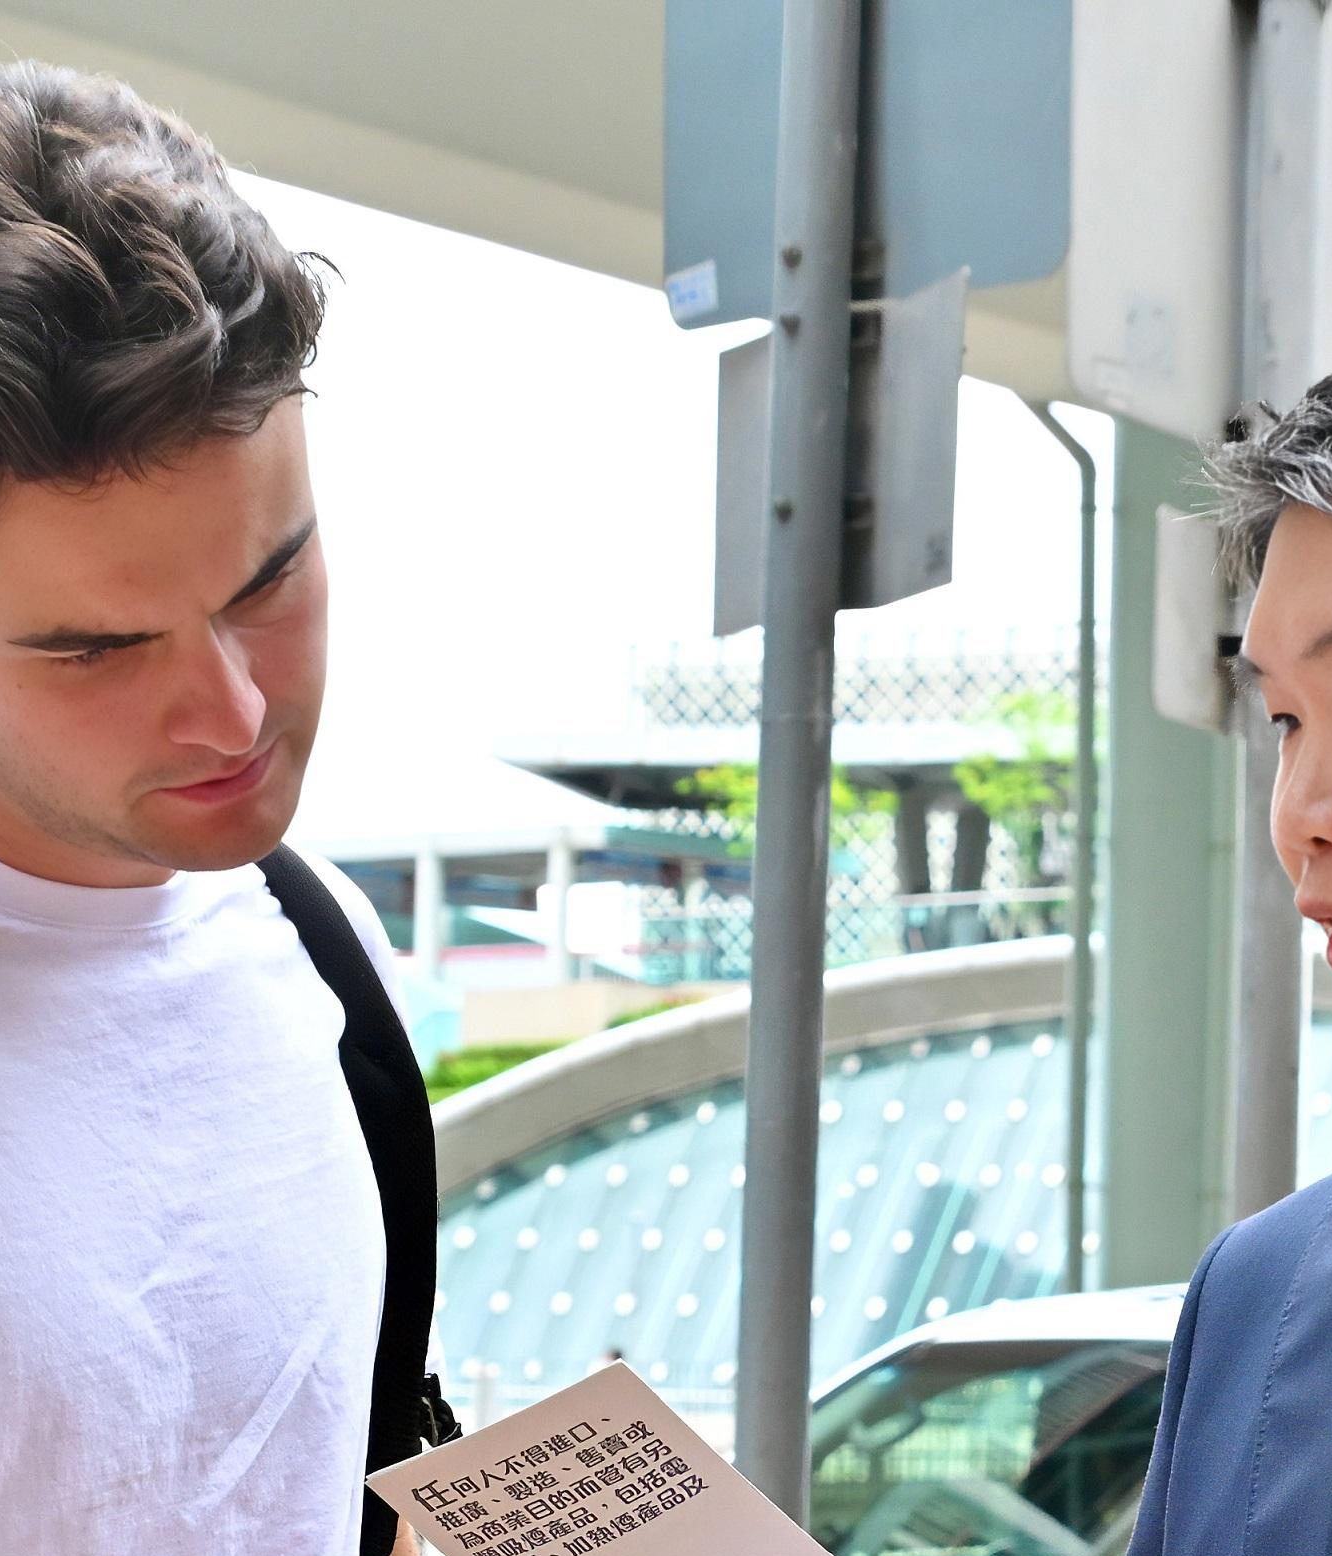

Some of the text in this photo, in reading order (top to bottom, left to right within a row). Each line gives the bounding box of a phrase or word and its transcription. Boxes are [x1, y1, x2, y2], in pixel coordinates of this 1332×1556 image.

[411, 1417, 611, 1513] 任何人不得進口、
[435, 1420, 655, 1532] 推廣、製造、售賣或
[453, 1438, 673, 1550] 為商業目的而管有另
